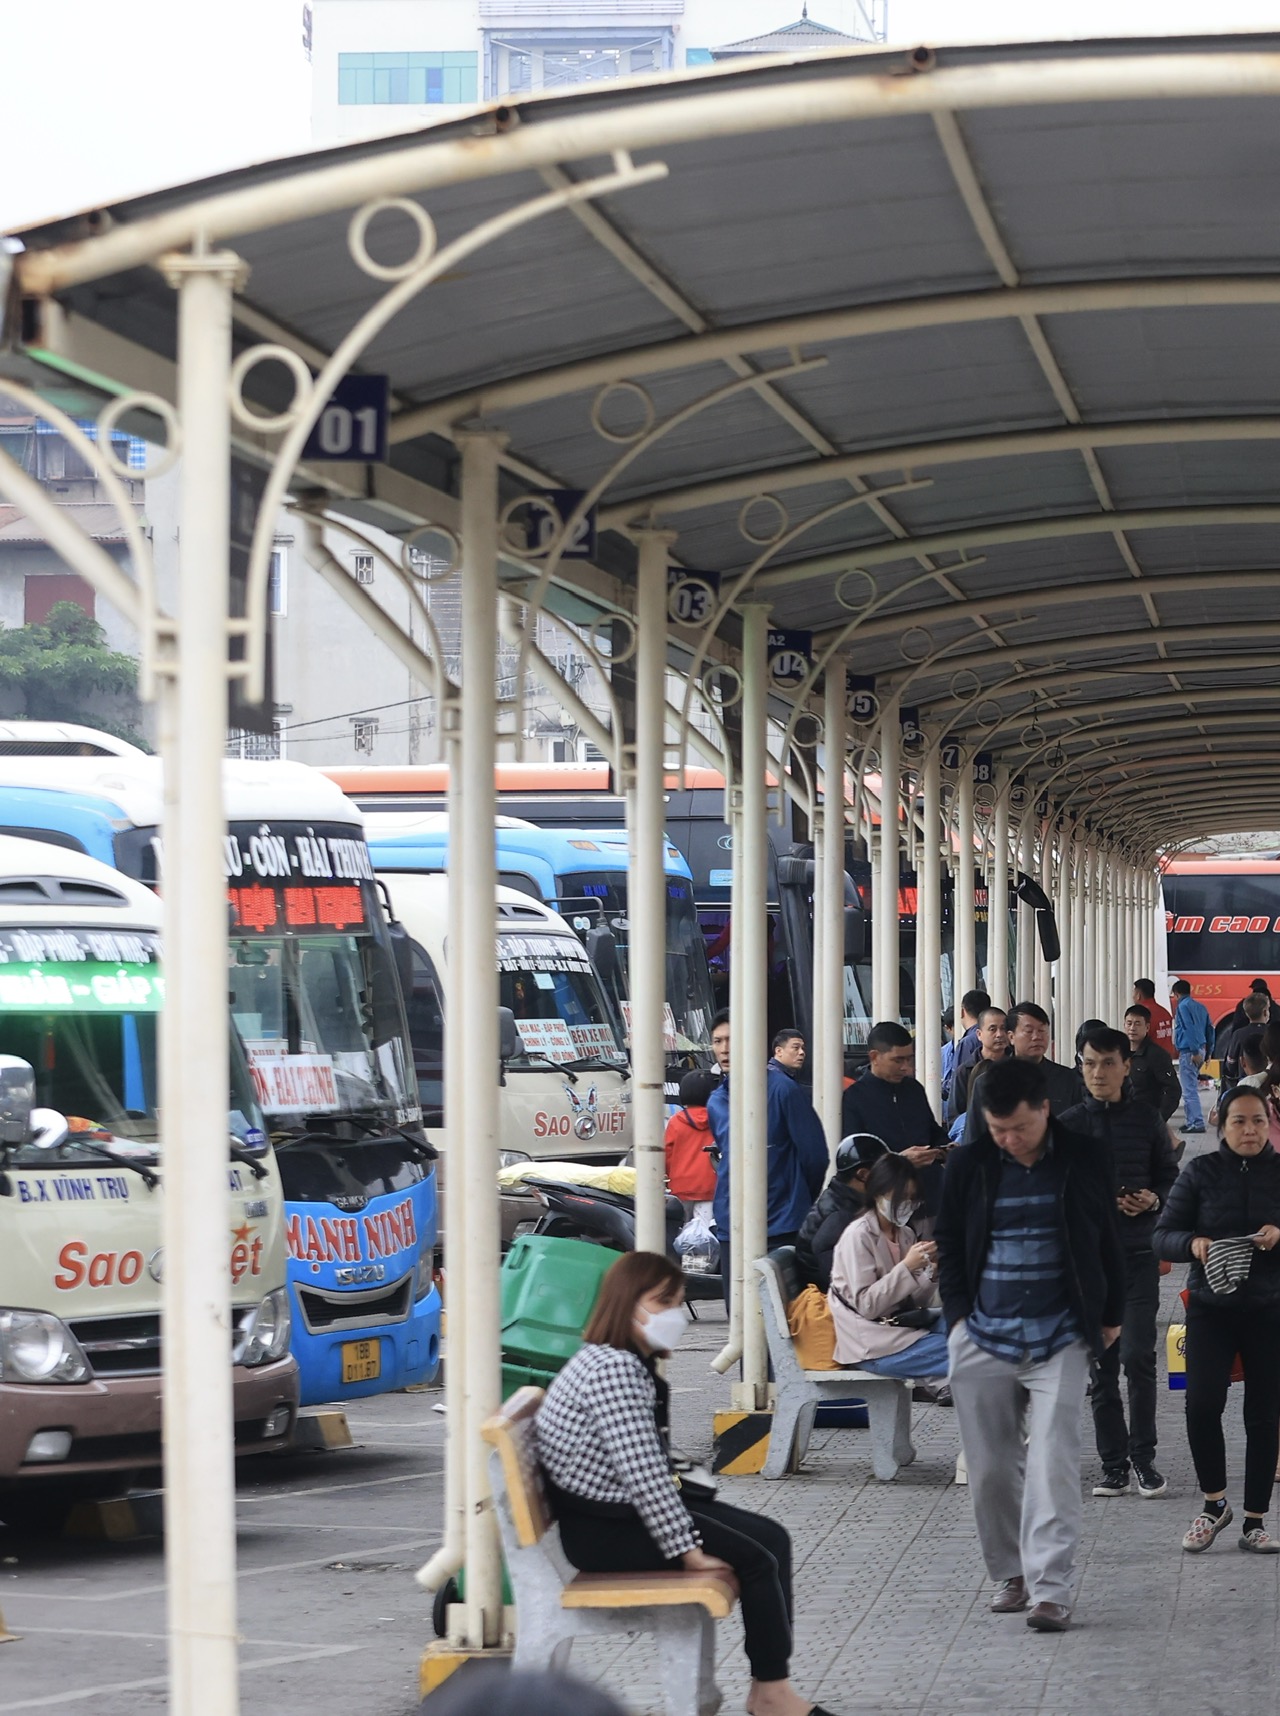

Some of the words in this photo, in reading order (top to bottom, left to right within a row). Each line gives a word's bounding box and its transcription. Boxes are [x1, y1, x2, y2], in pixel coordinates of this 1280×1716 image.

[318, 406, 378, 454] 01
[674, 589, 711, 620] 03
[767, 634, 786, 647] A2
[295, 826, 333, 879] HẢI
[326, 837, 376, 887] THỊNH
[1209, 915, 1271, 934] cao
[570, 1025, 590, 1044] BẾN
[587, 1028, 600, 1043] XE
[533, 1111, 571, 1137] SAO
[17, 1178, 51, 1203] B.X
[52, 1174, 96, 1201] VĨNH
[96, 1176, 130, 1203] TRỤ
[286, 1213, 362, 1274] MẠNH
[363, 1197, 418, 1261] NINH
[55, 1240, 145, 1290] Sao
[334, 1264, 385, 1287] ISUZU
